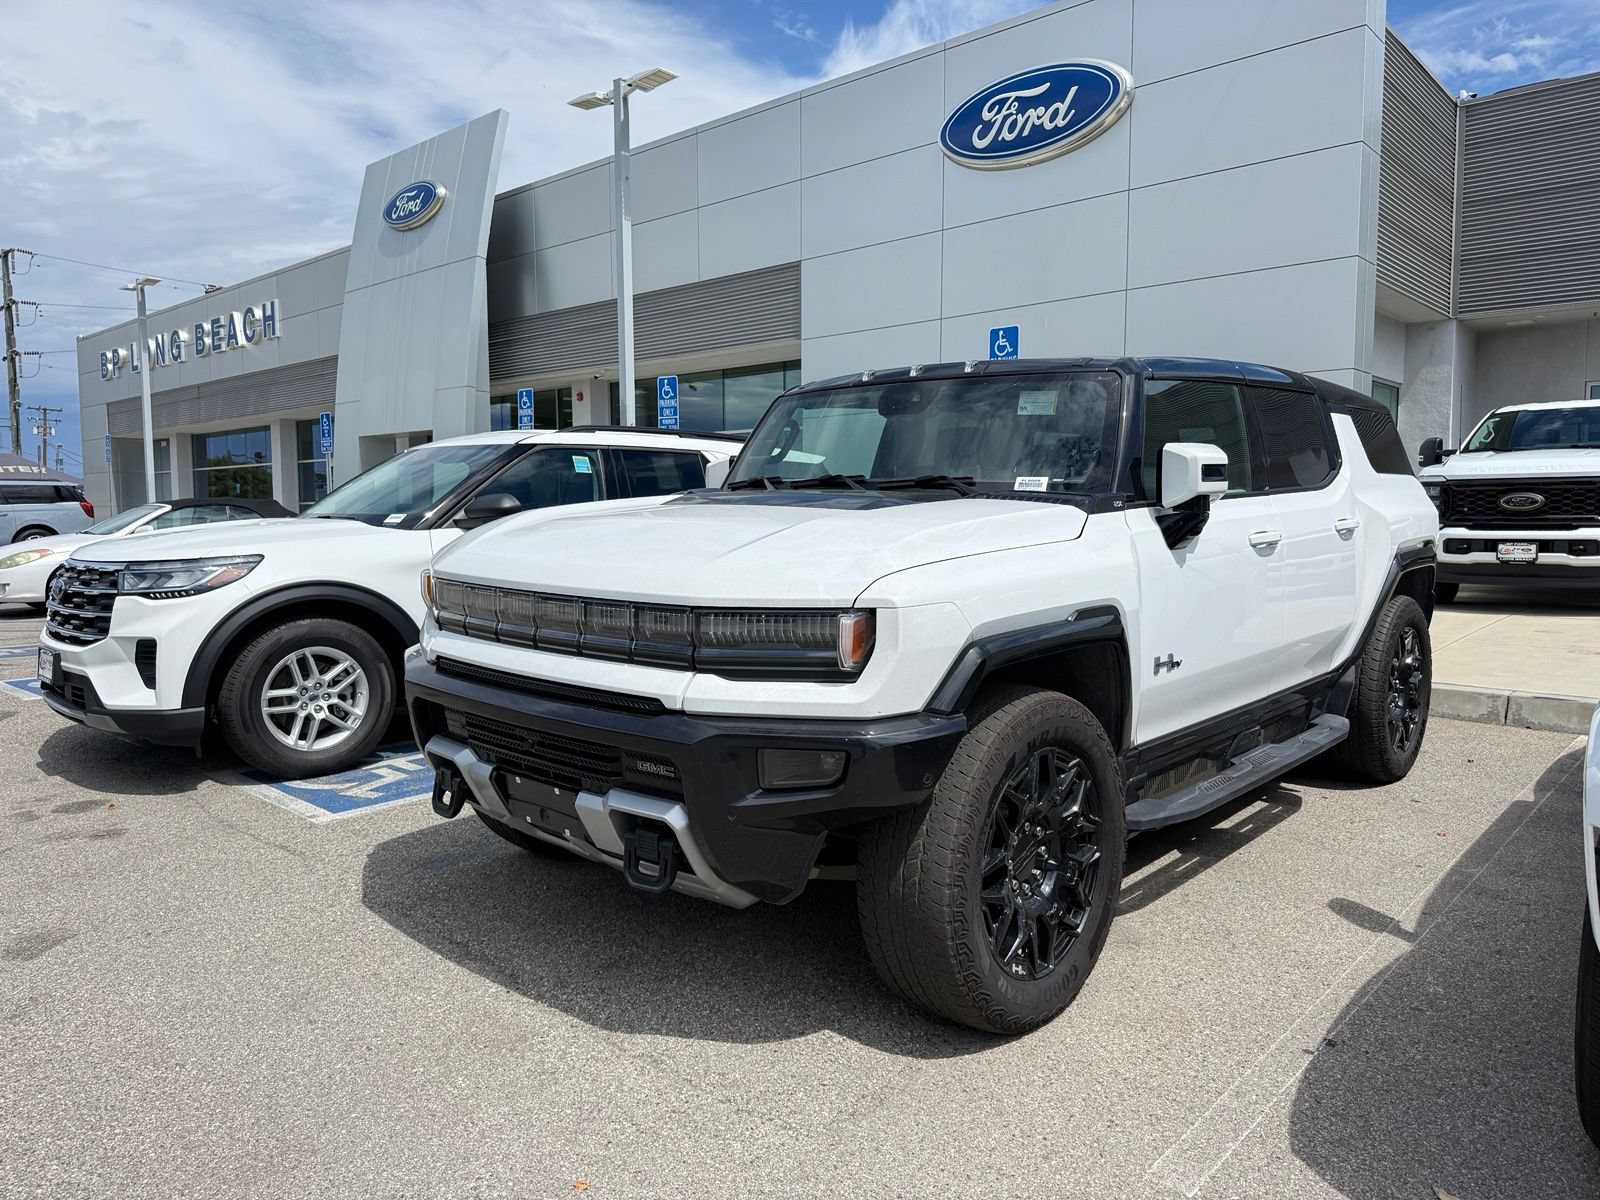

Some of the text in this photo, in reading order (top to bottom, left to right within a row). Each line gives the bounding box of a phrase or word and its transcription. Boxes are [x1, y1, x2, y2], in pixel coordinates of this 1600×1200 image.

[972, 82, 1079, 149] Ford
[391, 189, 425, 220] Ford
[130, 328, 187, 374] LNG
[194, 299, 280, 359] BEACH
[662, 408, 675, 416] ONLY
[636, 760, 675, 777] GMC
